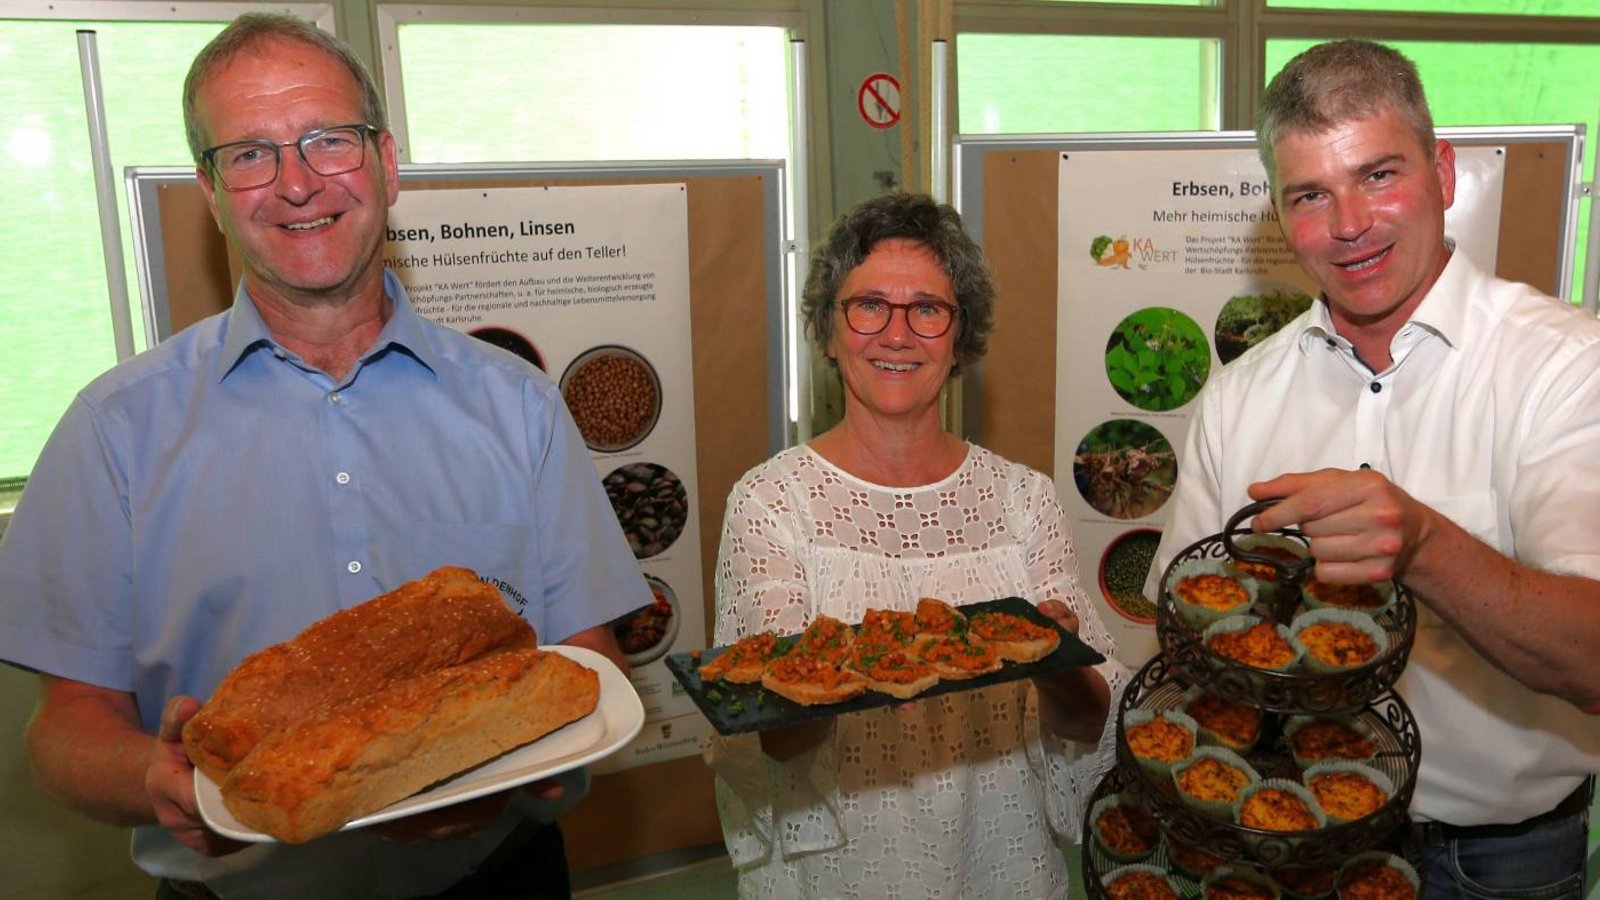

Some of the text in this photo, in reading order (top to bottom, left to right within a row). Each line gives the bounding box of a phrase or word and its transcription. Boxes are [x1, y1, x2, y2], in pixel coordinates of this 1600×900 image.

[1172, 181, 1234, 198] Erbsen,
[1153, 210, 1187, 222] Mehr
[1191, 209, 1257, 222] heimische
[386, 220, 575, 243] bsen, Bohnen, Linsen
[1133, 238, 1154, 252] KA
[383, 244, 626, 268] mische Hülsenfrüchte auf den Teller!
[1140, 250, 1178, 262] WERT
[503, 278, 517, 287] den
[519, 277, 545, 286] Aufbau
[547, 276, 561, 285] und
[562, 276, 574, 284] die
[642, 272, 656, 280] von
[464, 304, 476, 312] die
[514, 300, 528, 308] und
